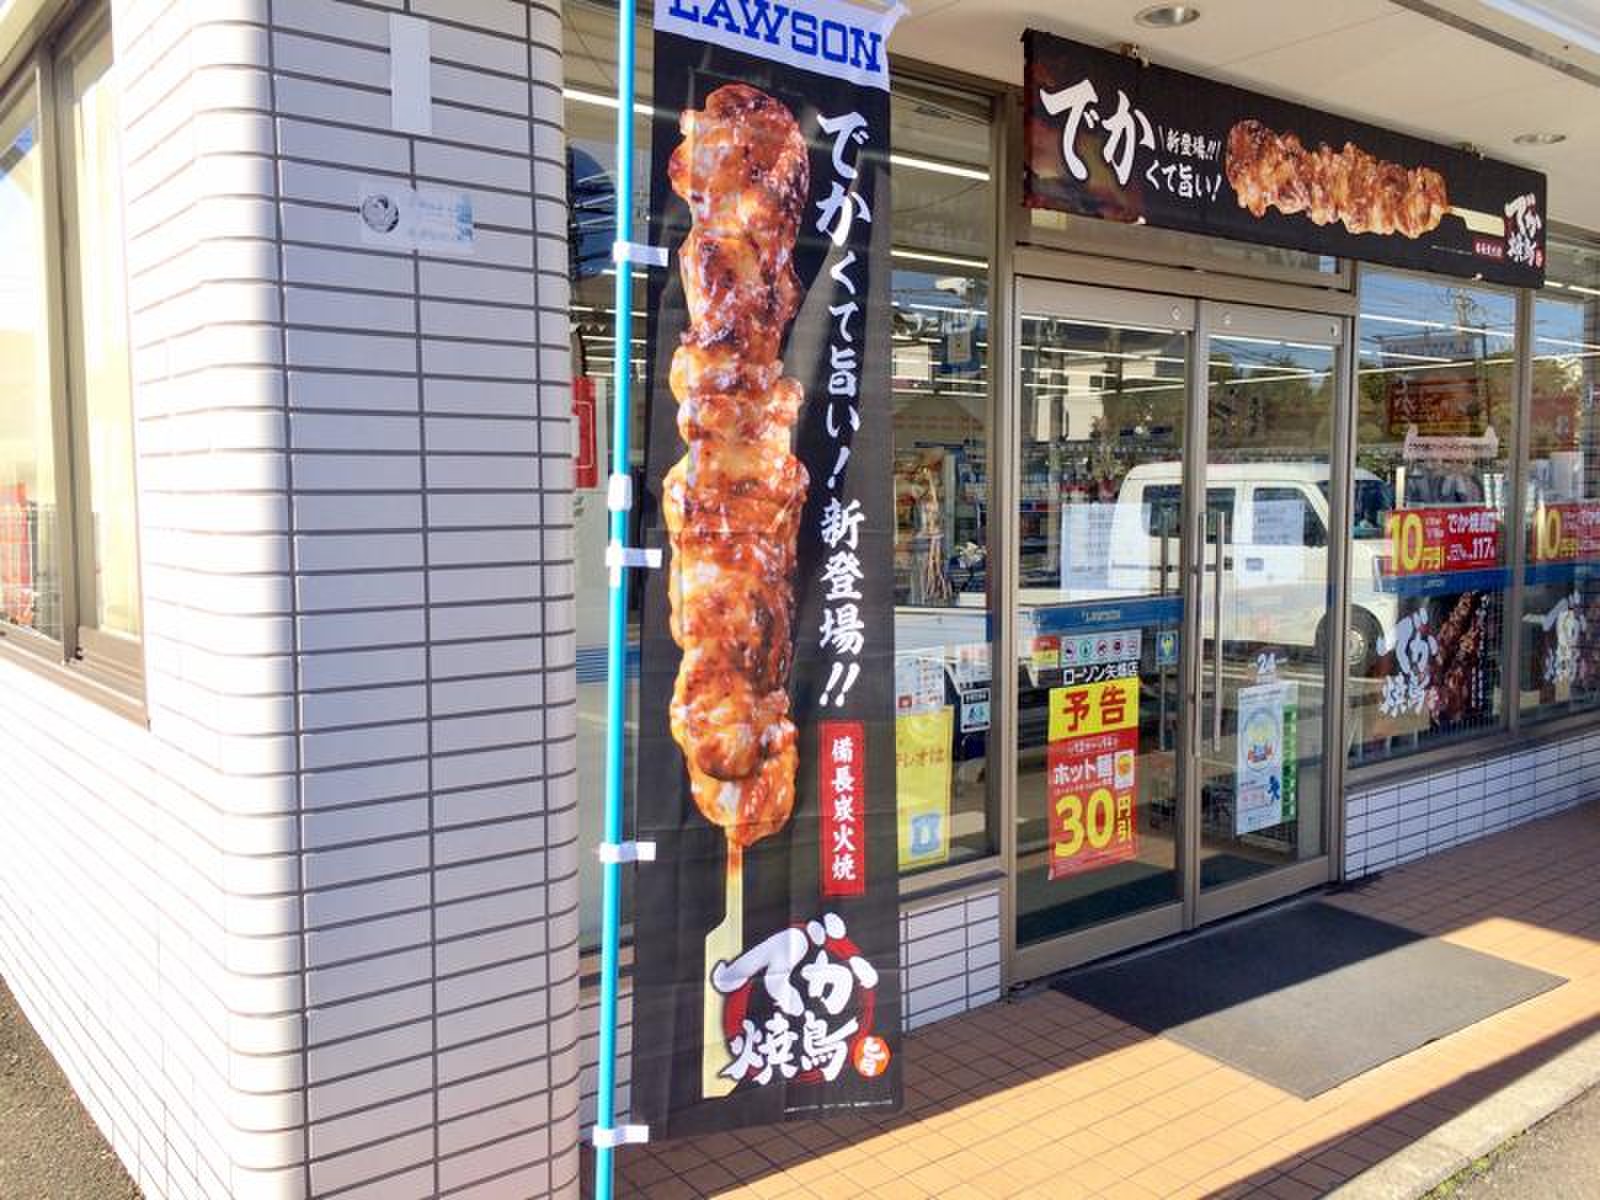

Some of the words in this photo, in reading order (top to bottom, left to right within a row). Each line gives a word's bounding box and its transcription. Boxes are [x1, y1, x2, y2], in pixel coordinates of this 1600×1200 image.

[669, 0, 881, 73] LAWSON
[1039, 79, 1156, 185] でか
[1063, 685, 1127, 732] 予告
[832, 736, 856, 881] 備長炭火焼
[1054, 788, 1115, 858] 30
[714, 912, 878, 1016] でか
[720, 1012, 860, 1084] 焼鳥
